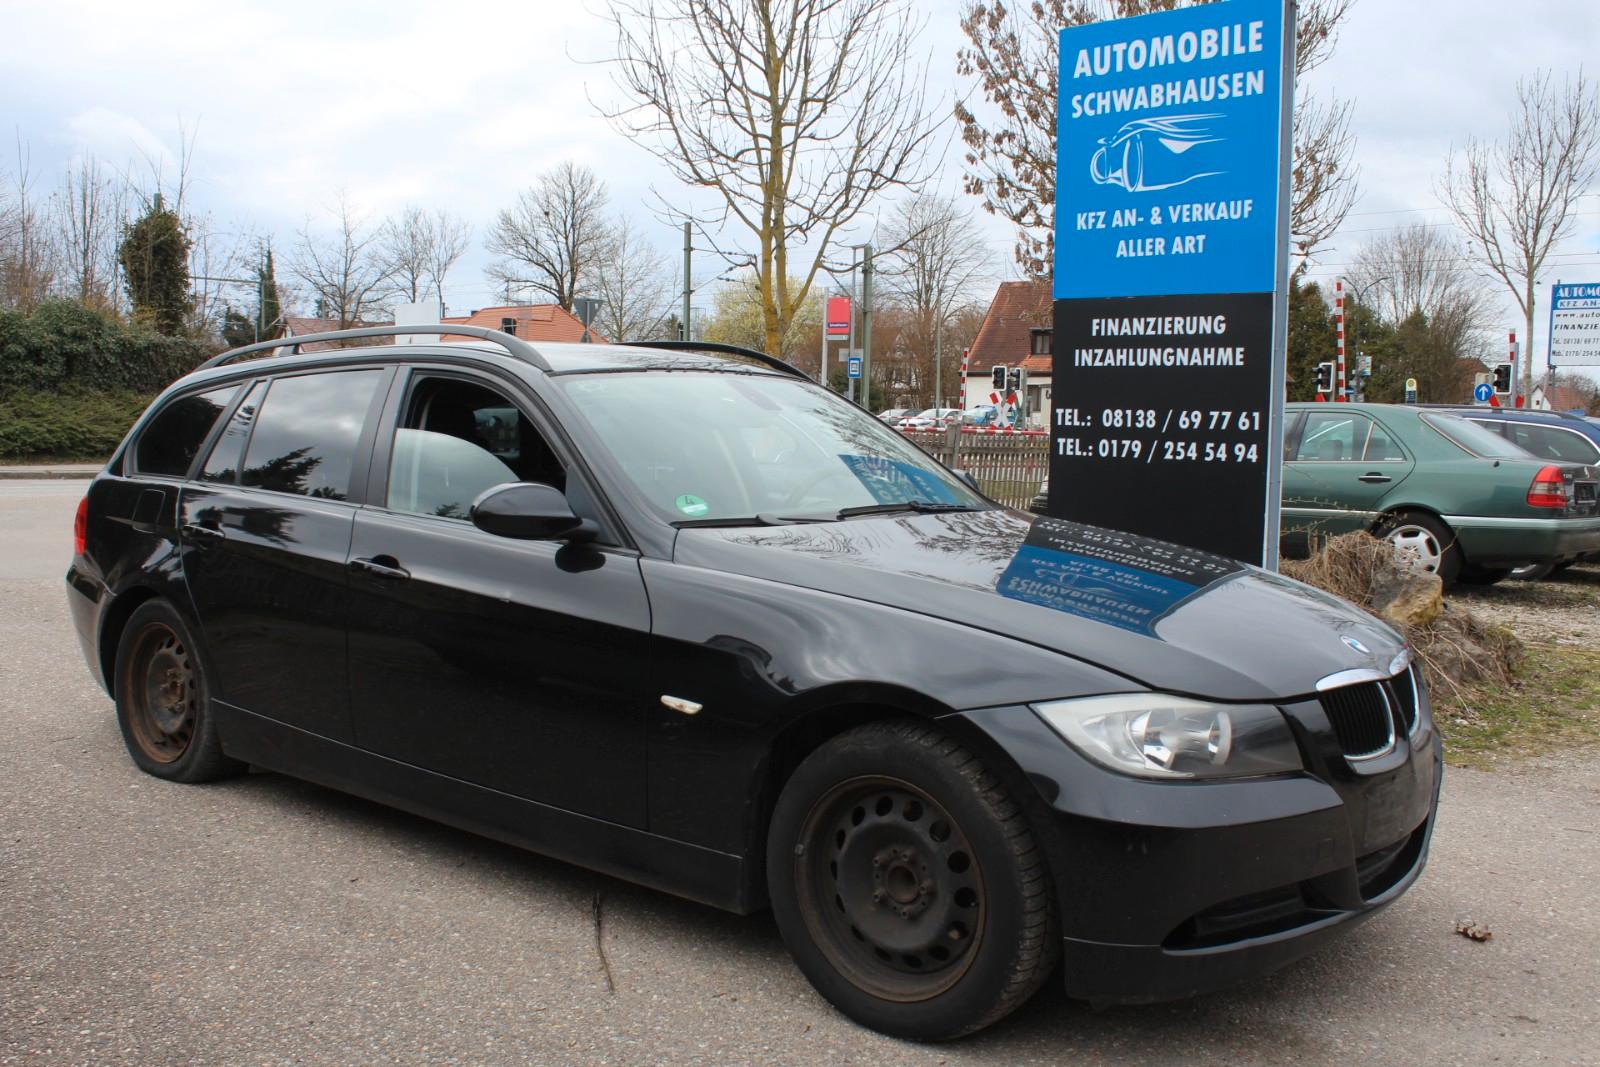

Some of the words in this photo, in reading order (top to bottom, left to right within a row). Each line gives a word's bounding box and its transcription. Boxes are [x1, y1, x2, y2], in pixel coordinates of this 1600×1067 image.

[1073, 20, 1264, 79] AUTOMOBILE
[1071, 69, 1265, 119] SCHWABHAUSEN
[1076, 211, 1106, 230] KFZ
[1111, 208, 1144, 228] AN-
[1150, 206, 1163, 225] &
[1168, 199, 1253, 224] VERKAUF
[1115, 238, 1165, 258] ALLER
[1171, 235, 1206, 255] ART
[1091, 315, 1227, 336] FINANZIERUNG
[1074, 347, 1245, 367] INZAHLUNGNAHME
[1055, 408, 1092, 427] TEL.:
[1102, 409, 1156, 429] 08138
[1162, 409, 1173, 433] /
[1178, 410, 1202, 430] 69
[1208, 411, 1233, 430] 77
[1238, 412, 1261, 431] 61
[1057, 438, 1093, 457] TEL.:
[1098, 439, 1142, 458] 0179
[1146, 440, 1158, 464] /
[1163, 441, 1198, 461] 254
[1204, 443, 1228, 462] 54
[1234, 443, 1258, 463] 94
